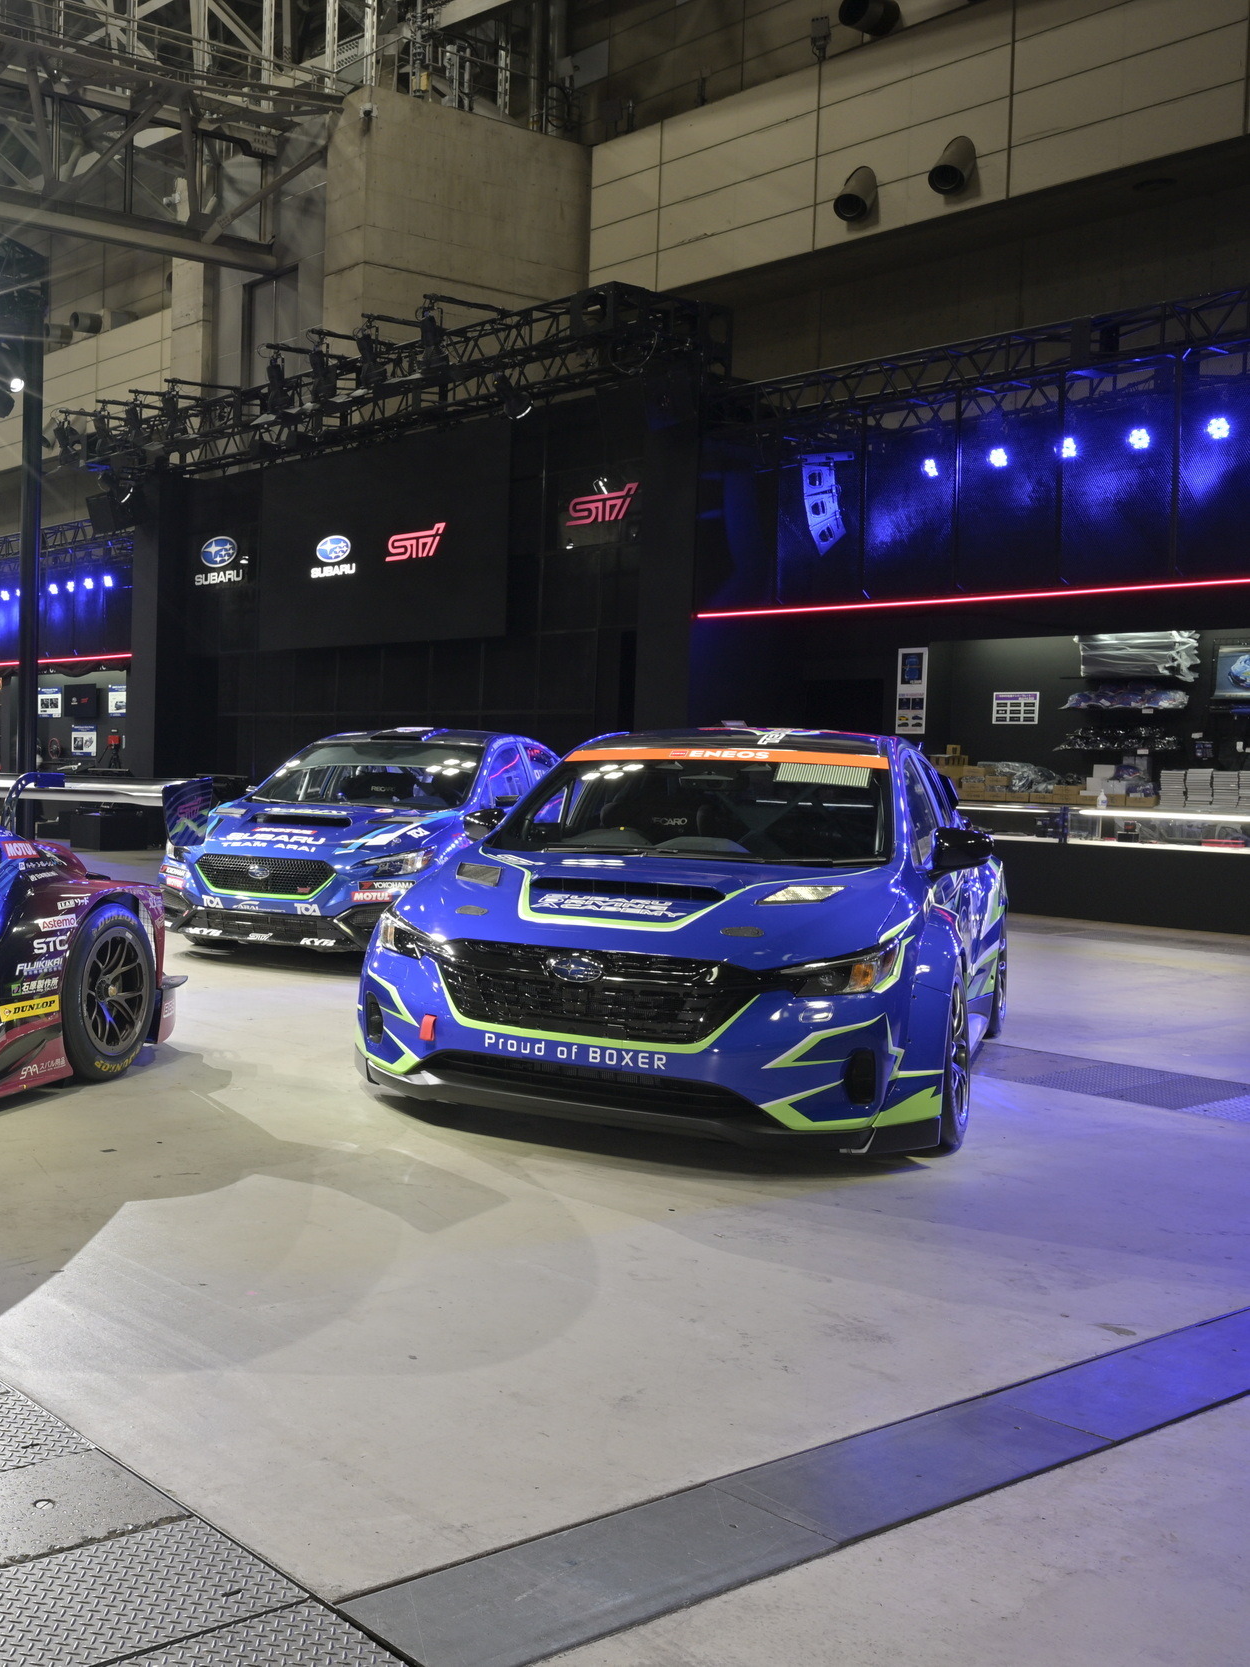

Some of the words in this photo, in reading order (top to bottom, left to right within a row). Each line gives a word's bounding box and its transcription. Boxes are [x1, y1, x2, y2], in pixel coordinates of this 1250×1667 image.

[194, 569, 243, 586] SUBARU
[310, 563, 356, 578] SUBARU
[688, 750, 770, 759] ENEOS
[219, 832, 326, 845] SUBARU
[4, 842, 38, 857] MOTUL
[273, 843, 317, 853] ARAI
[202, 894, 224, 908] TOA
[353, 891, 390, 901] MOTUL
[545, 893, 673, 906] SUBARU
[294, 903, 321, 916] TOA
[530, 903, 688, 917] ACADEMY
[42, 917, 76, 930] Astemo
[33, 935, 69, 954] STC
[299, 938, 336, 946] KYB
[15, 957, 63, 975] FUJIKIKAI
[13, 1000, 56, 1014] DUNLOP
[484, 1033, 545, 1056] Proud
[557, 1045, 578, 1060] of
[588, 1047, 667, 1070] BOXER
